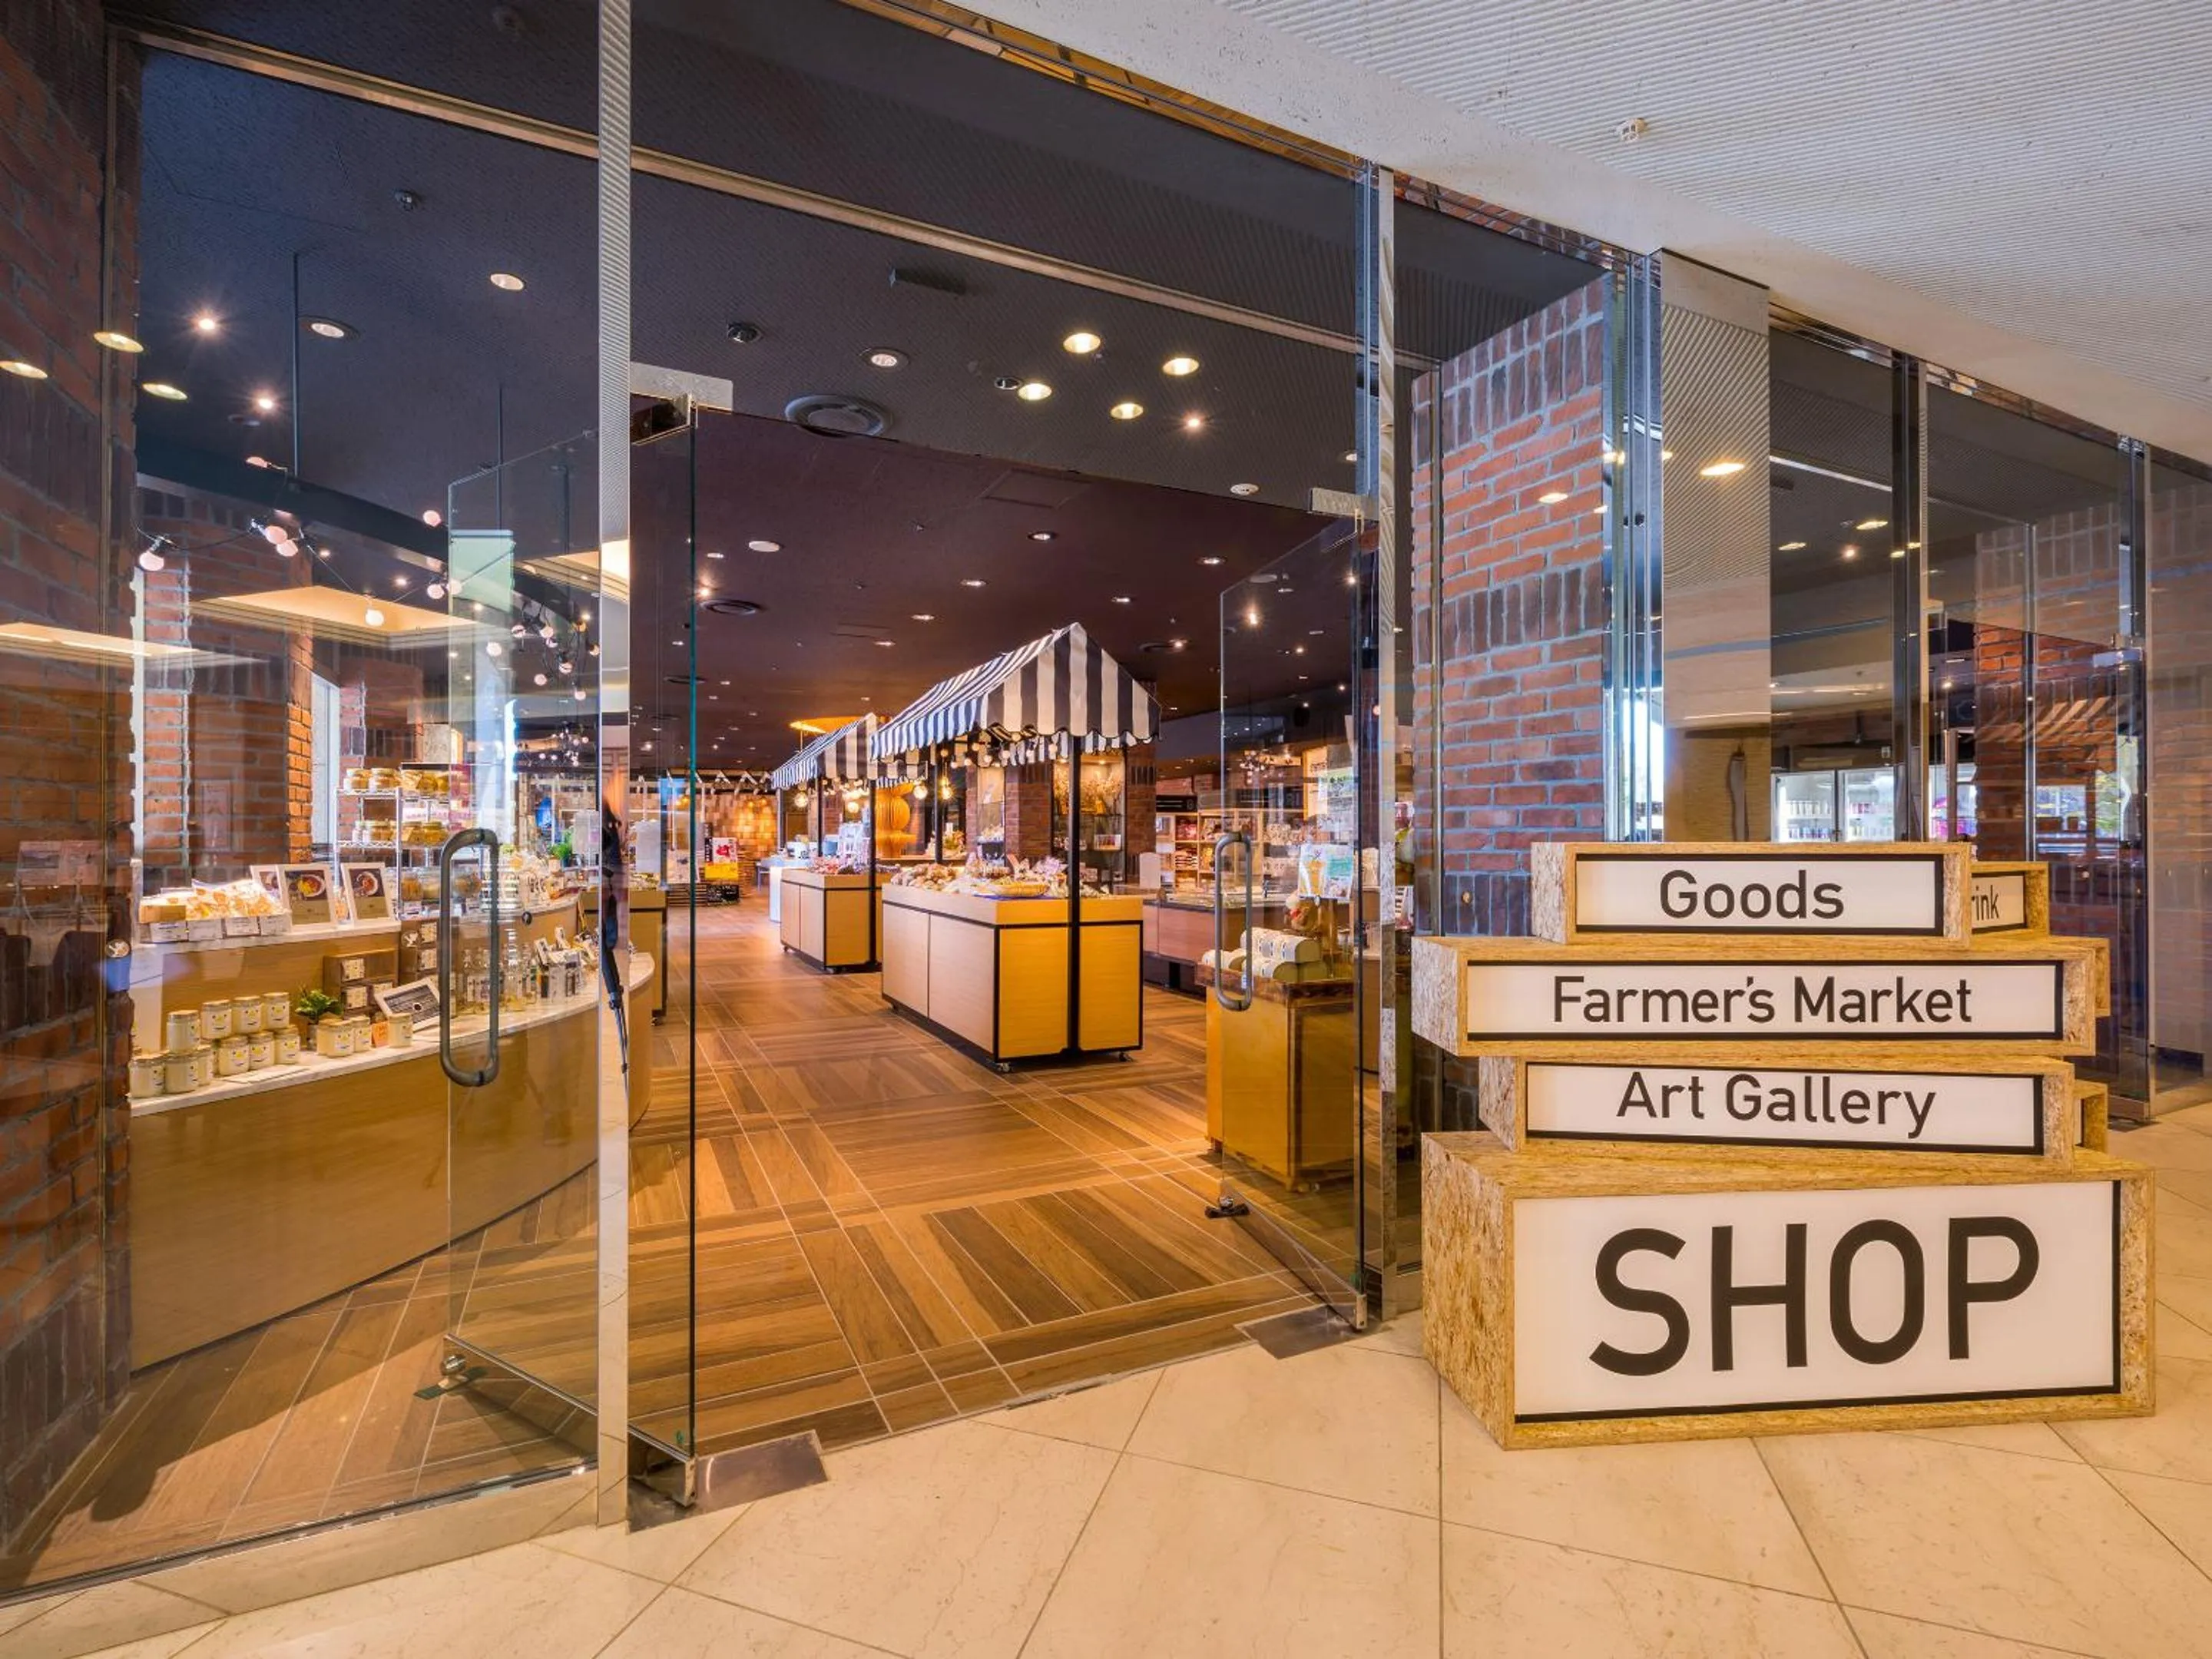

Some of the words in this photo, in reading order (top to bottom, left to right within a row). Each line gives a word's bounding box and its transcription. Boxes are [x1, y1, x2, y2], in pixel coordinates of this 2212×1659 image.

[1659, 869, 1845, 920] Goods
[1553, 975, 1776, 1024] Farmer's
[1793, 975, 1972, 1024] Market
[1615, 1071, 1705, 1120] Art
[1725, 1072, 1936, 1140] Gallery
[1588, 1215, 2041, 1377] SHOP
